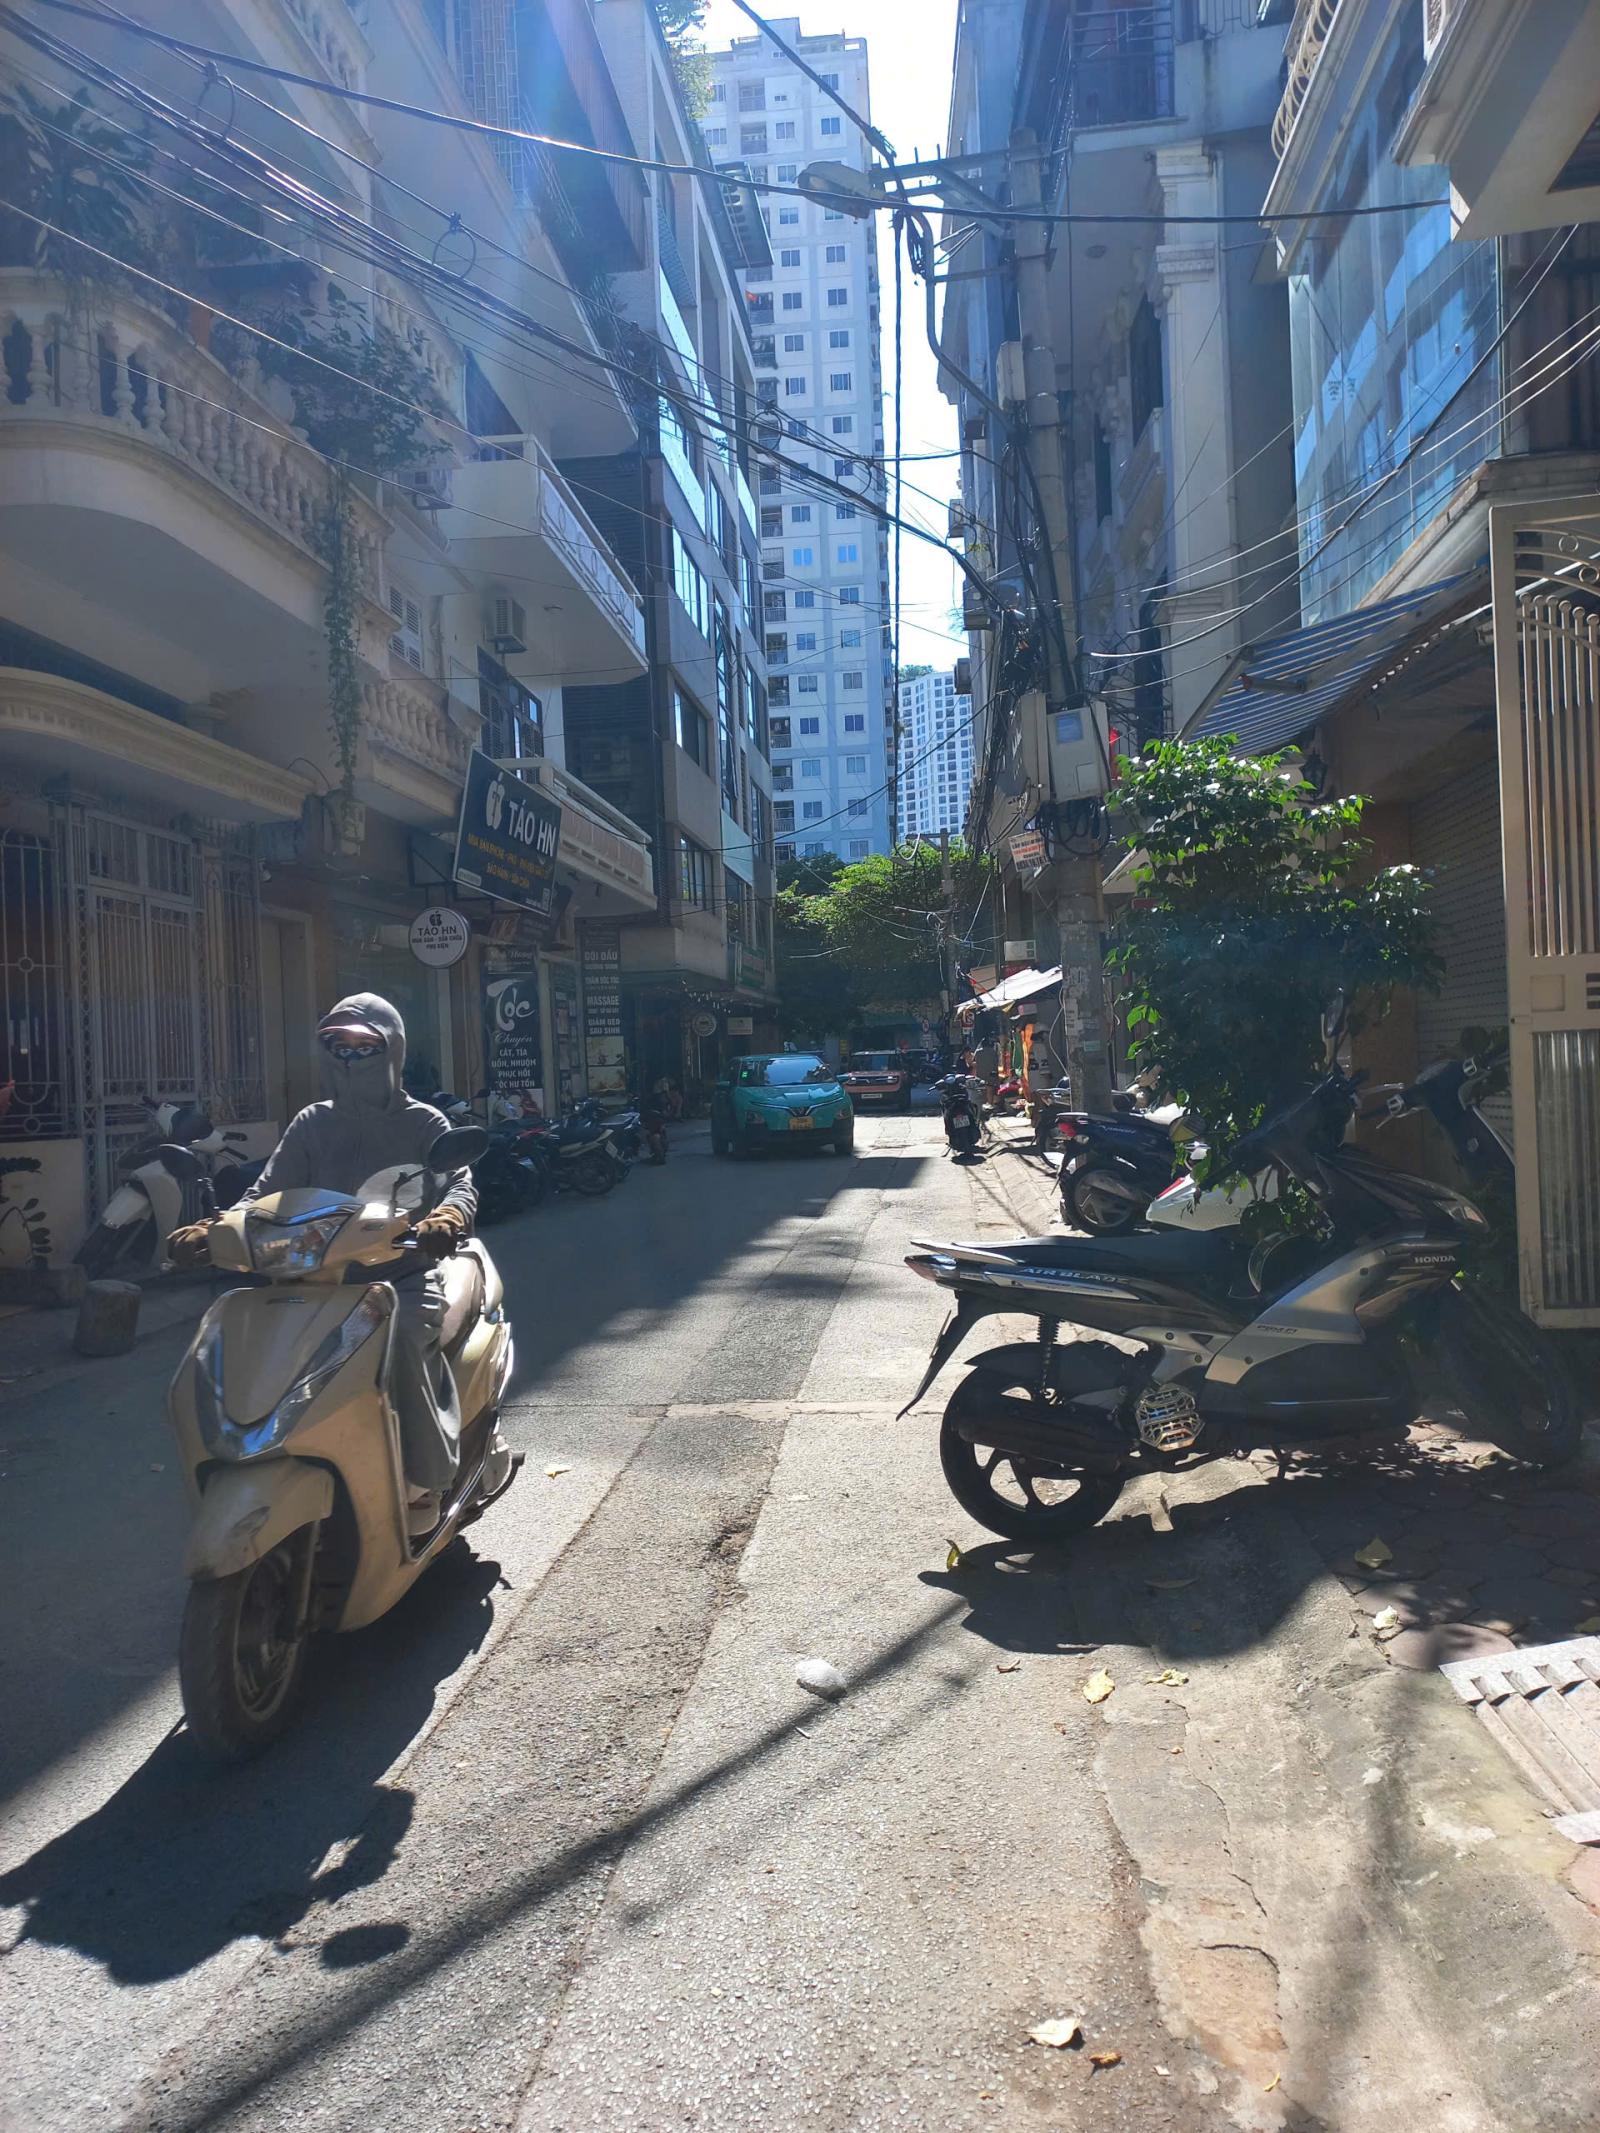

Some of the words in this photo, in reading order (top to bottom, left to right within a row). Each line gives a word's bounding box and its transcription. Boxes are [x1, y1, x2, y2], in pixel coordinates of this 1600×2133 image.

[508, 799, 536, 845] TÁO
[536, 819, 557, 857] HN
[441, 925, 457, 935] HN
[587, 995, 620, 1006] MASSAGE
[494, 1031, 533, 1048] Chuyên
[1414, 1255, 1456, 1264] HONDA
